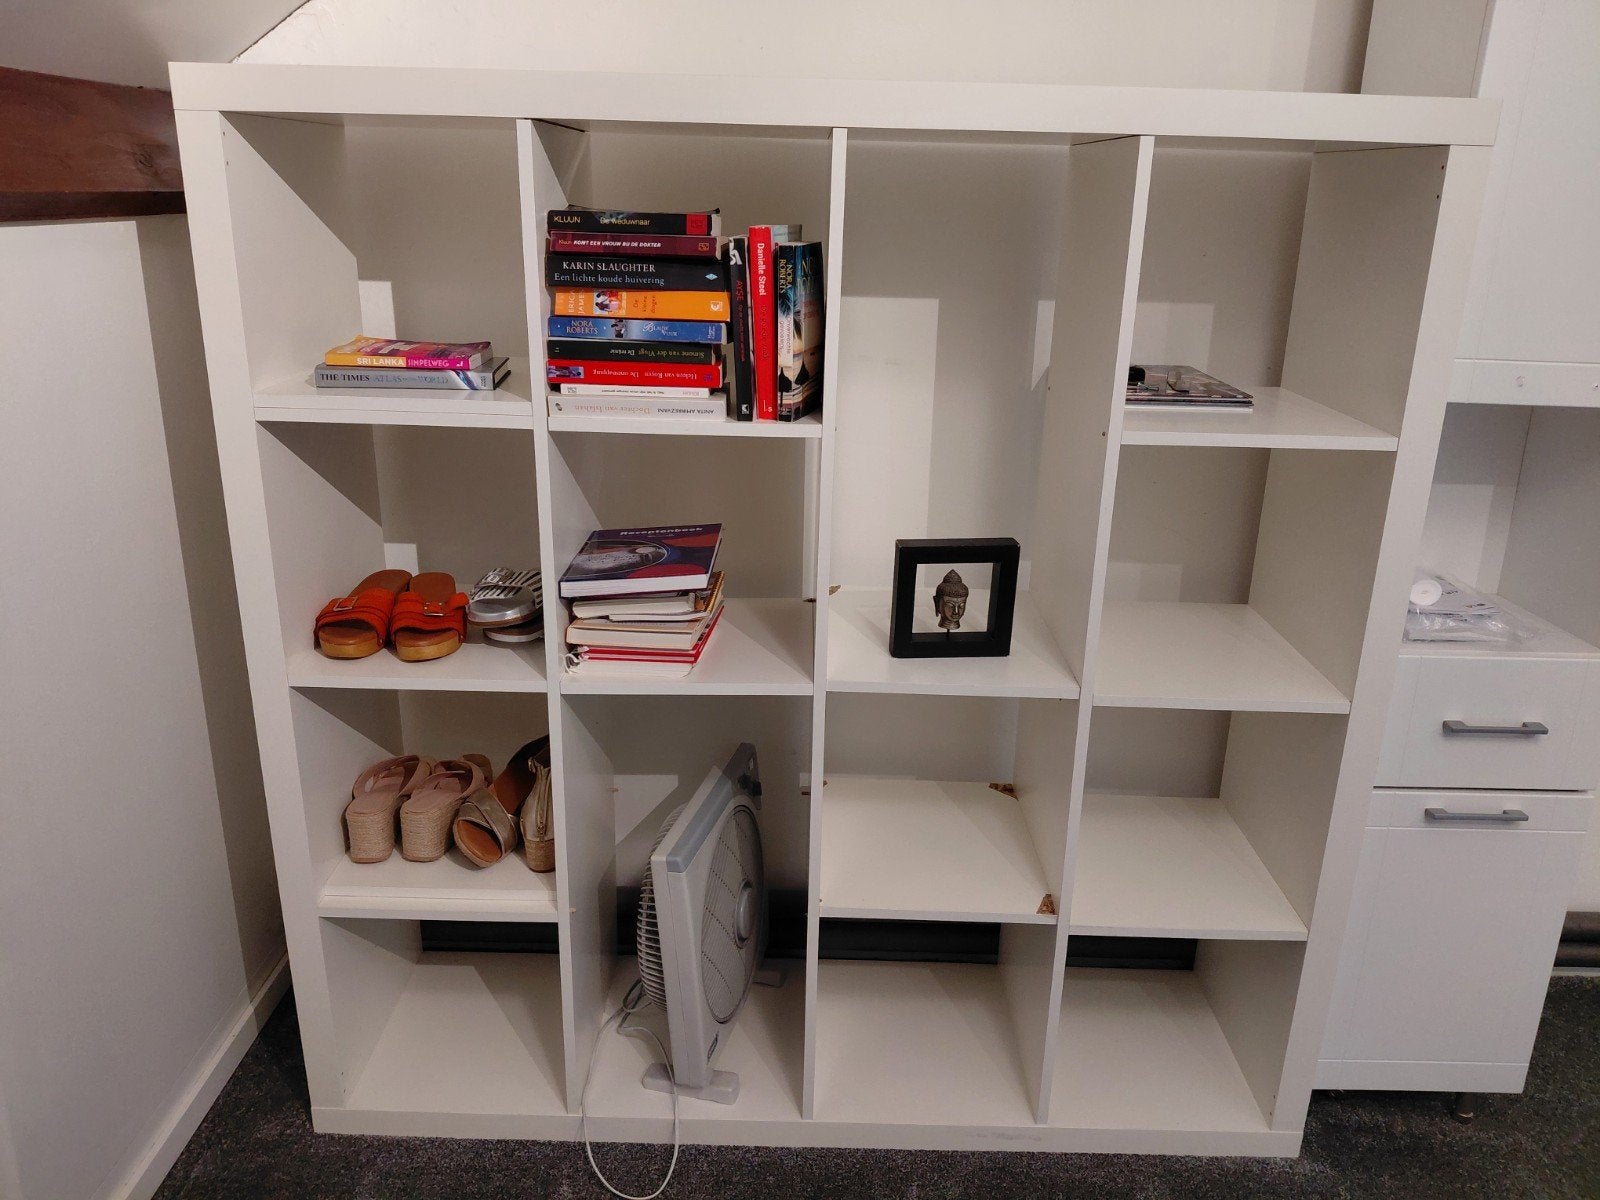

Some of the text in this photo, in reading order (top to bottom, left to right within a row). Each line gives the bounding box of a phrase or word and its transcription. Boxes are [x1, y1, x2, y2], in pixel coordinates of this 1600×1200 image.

[757, 242, 767, 274] Danielle
[562, 261, 656, 272] KARIN SLAUGHTER
[554, 272, 665, 286] Een lichte koude huivering
[779, 259, 787, 294] ROBERTS
[786, 264, 794, 288] NORA
[758, 276, 767, 296] Steel
[566, 326, 598, 334] ROBERTS
[373, 358, 404, 366] LANKA
[320, 373, 339, 381] THE
[341, 374, 370, 382] TIMES
[645, 370, 663, 379] Royen
